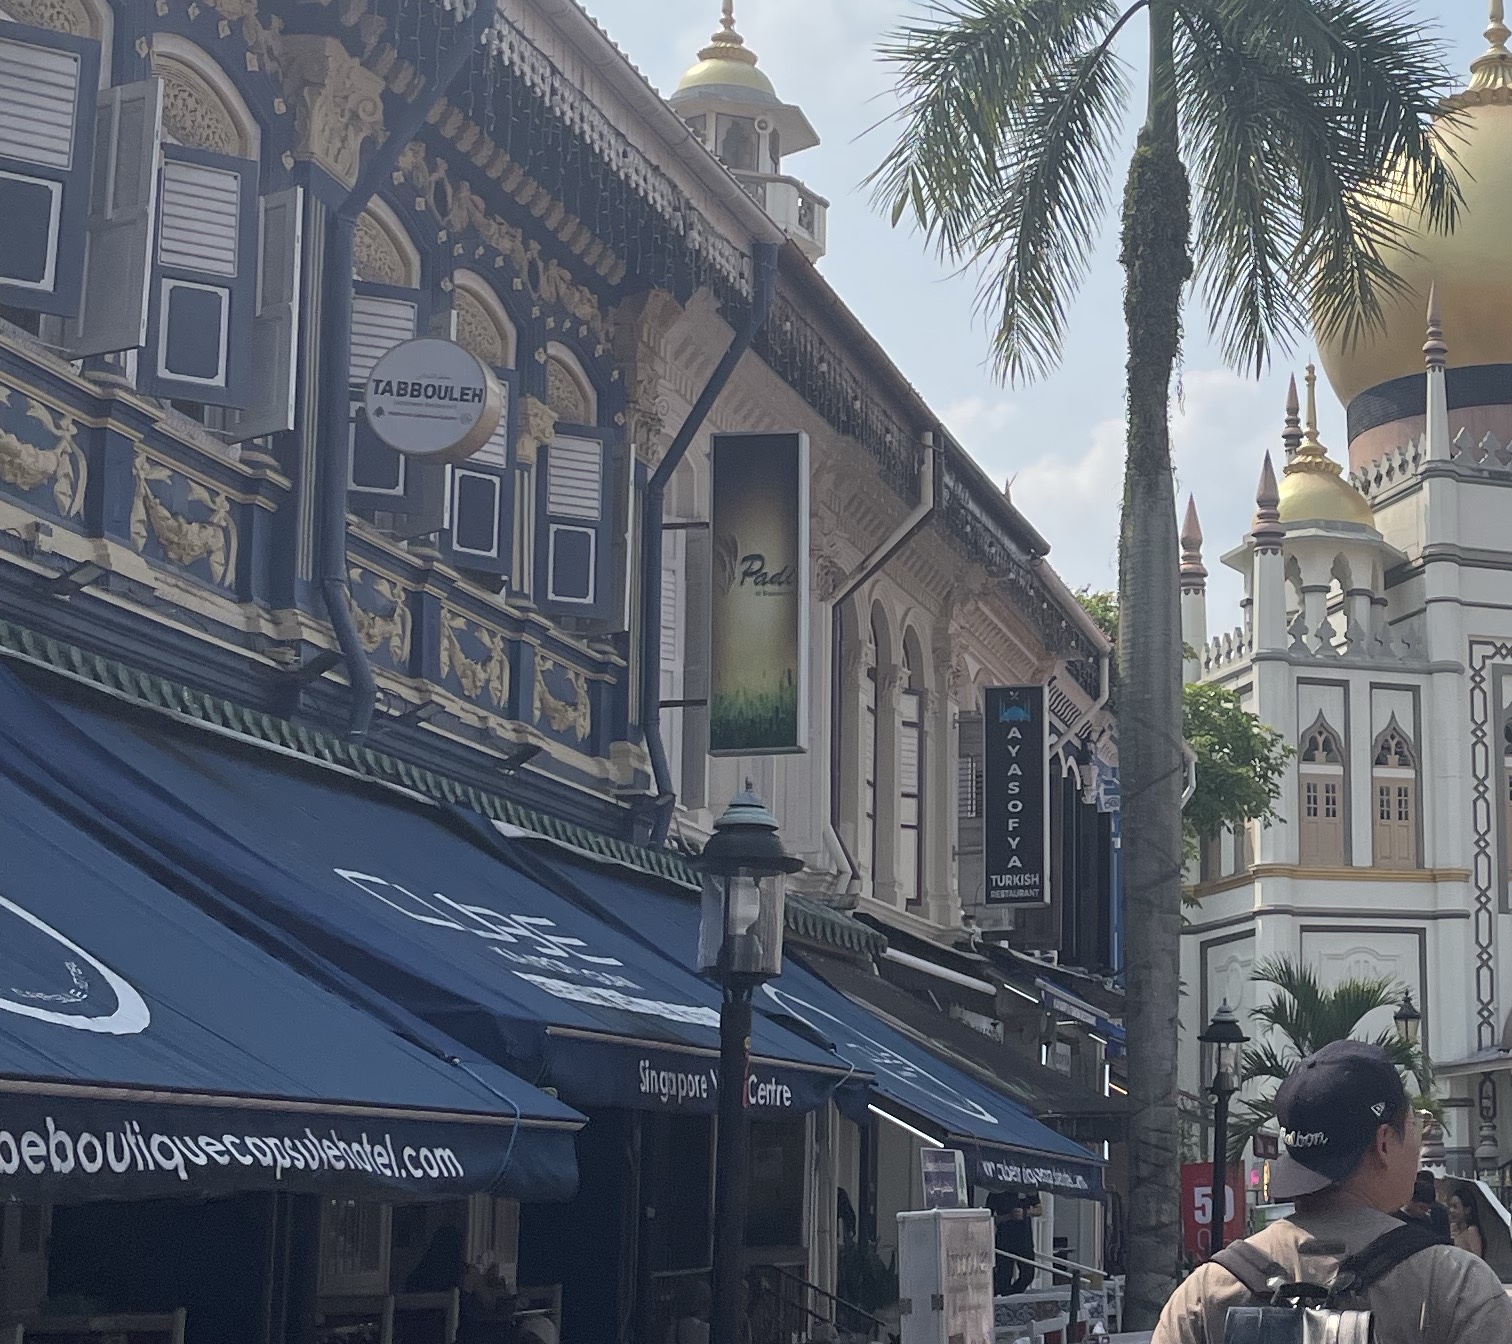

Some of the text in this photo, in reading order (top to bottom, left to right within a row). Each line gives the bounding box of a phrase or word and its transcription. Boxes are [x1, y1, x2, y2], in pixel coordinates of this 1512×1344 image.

[372, 378, 484, 404] TABBOULEH
[1007, 726, 1023, 869] AYASOFYA
[989, 873, 1040, 887] TURKISH
[990, 888, 1040, 899] RESTAURANT
[638, 1058, 708, 1105] Singapore
[748, 1073, 793, 1107] Centre
